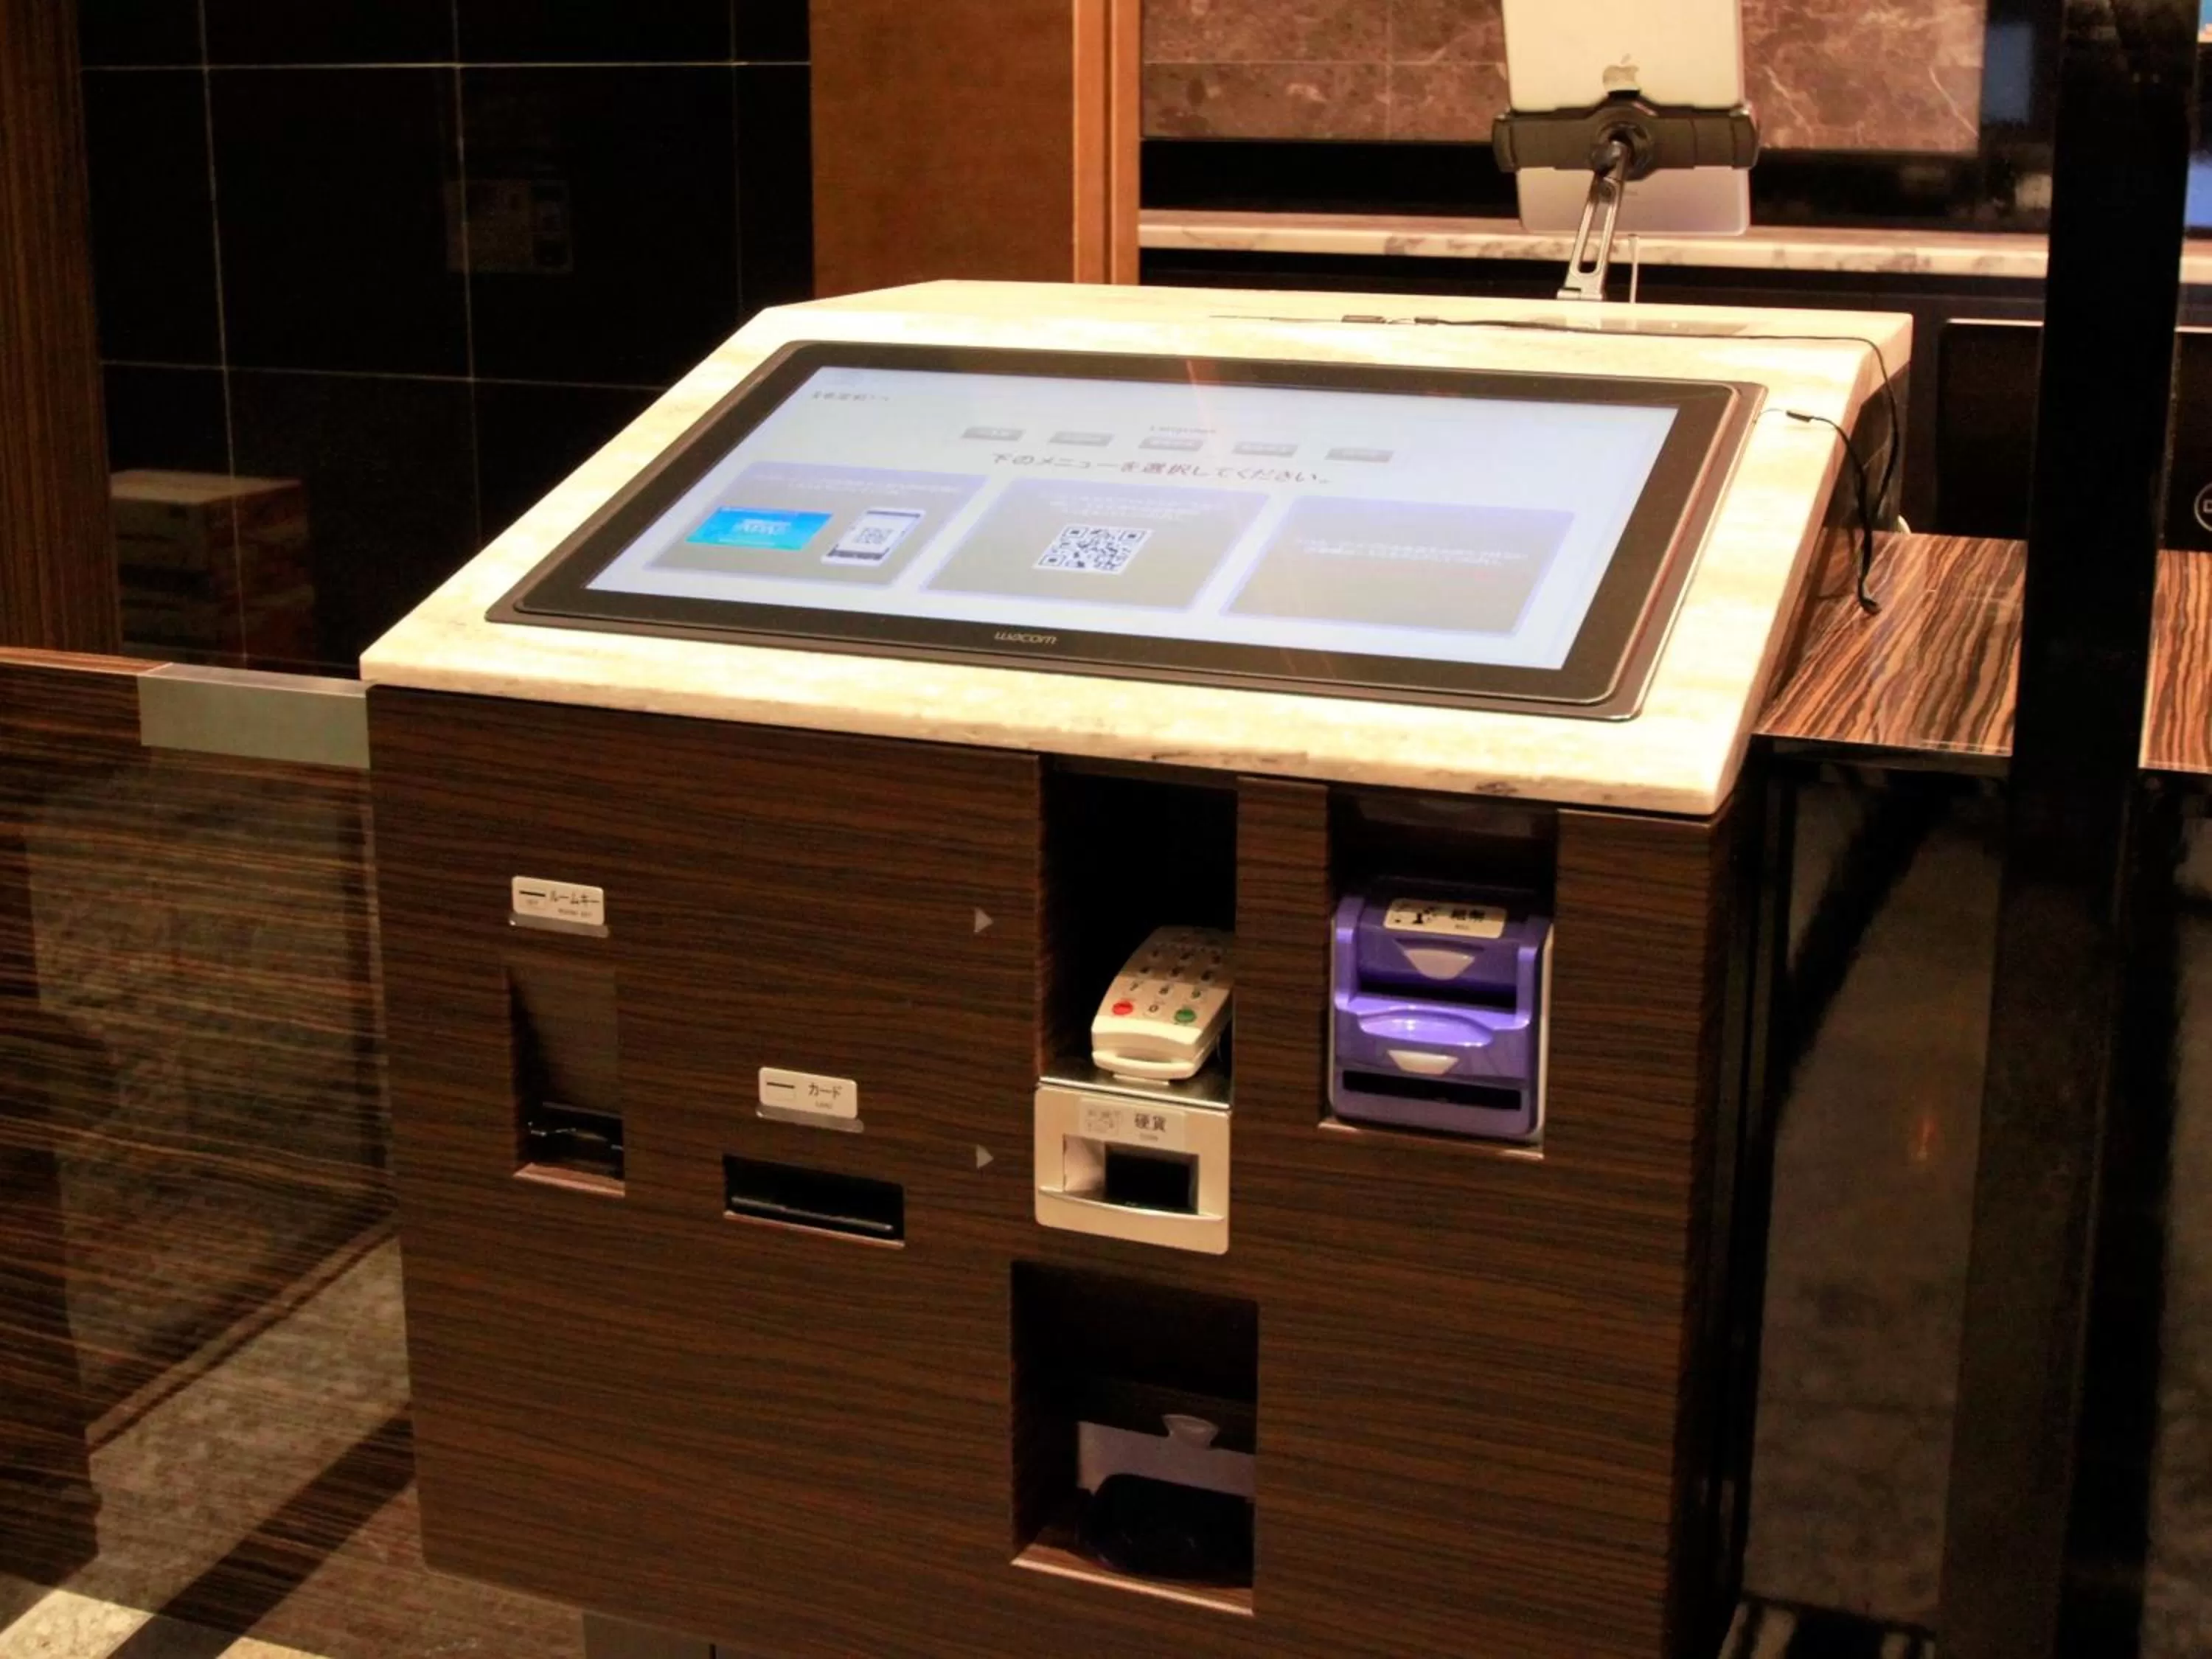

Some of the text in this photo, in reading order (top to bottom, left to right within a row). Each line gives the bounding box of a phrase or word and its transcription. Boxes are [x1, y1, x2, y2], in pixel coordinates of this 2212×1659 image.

[994, 631, 1057, 644] wacom
[808, 1082, 843, 1099] カード
[1135, 1113, 1166, 1132] 硬貨
